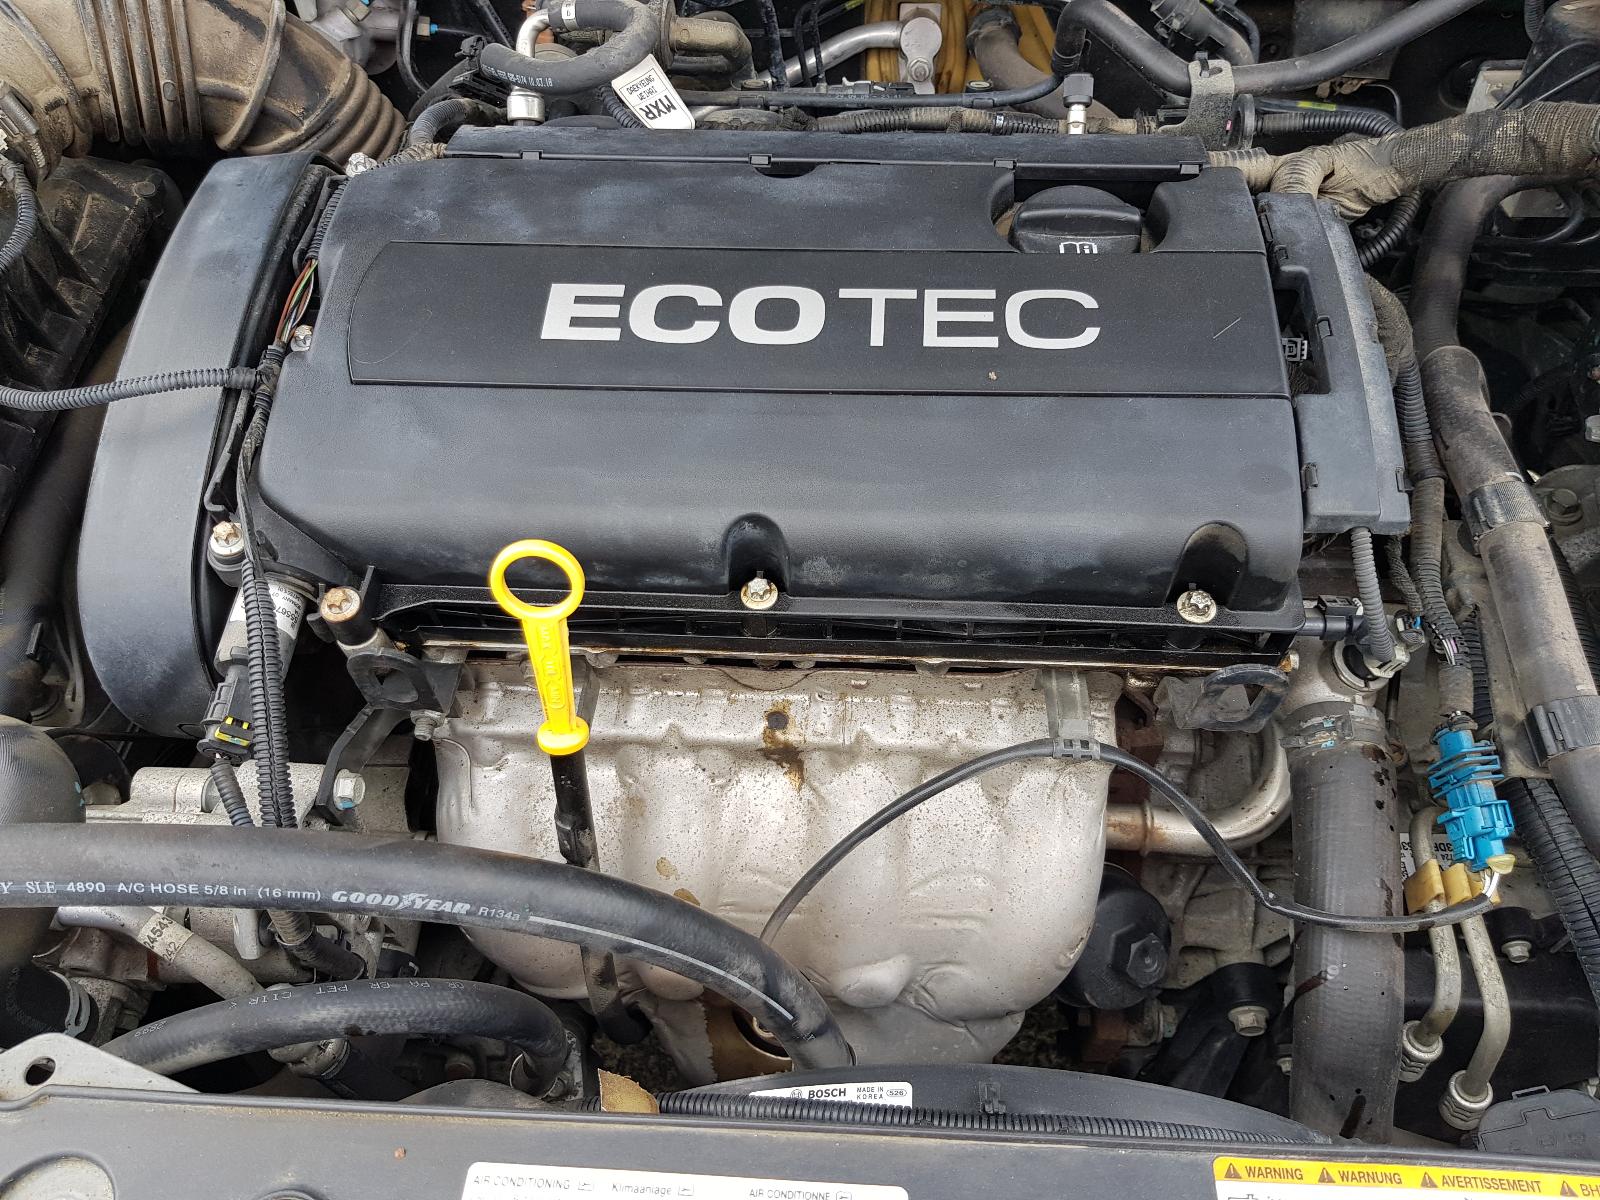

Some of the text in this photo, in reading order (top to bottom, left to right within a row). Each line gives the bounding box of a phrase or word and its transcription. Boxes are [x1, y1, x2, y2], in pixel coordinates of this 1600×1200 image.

[638, 95, 678, 121] MXR
[540, 283, 1102, 350] ECOTEC
[26, 881, 57, 894] SLE
[66, 881, 106, 893] 4890
[117, 882, 145, 893] A/C
[150, 882, 200, 894] HOSE
[204, 884, 229, 895] 5/8
[233, 885, 247, 896] in
[257, 887, 282, 899] (16
[287, 889, 321, 901] mm)
[331, 890, 471, 914] GOODYEAR
[477, 906, 521, 921] R134a
[315, 983, 349, 994] PET
[808, 1088, 847, 1099] BOSCH
[1245, 1165, 1304, 1181] WARNING
[1338, 1169, 1403, 1185] WARNUNG
[473, 1175, 571, 1190] AIR CONDITIONING
[612, 1182, 672, 1196] Klimaanlage
[1441, 1175, 1543, 1193] AVERTISSEMENT
[749, 1188, 764, 1198] AIR
